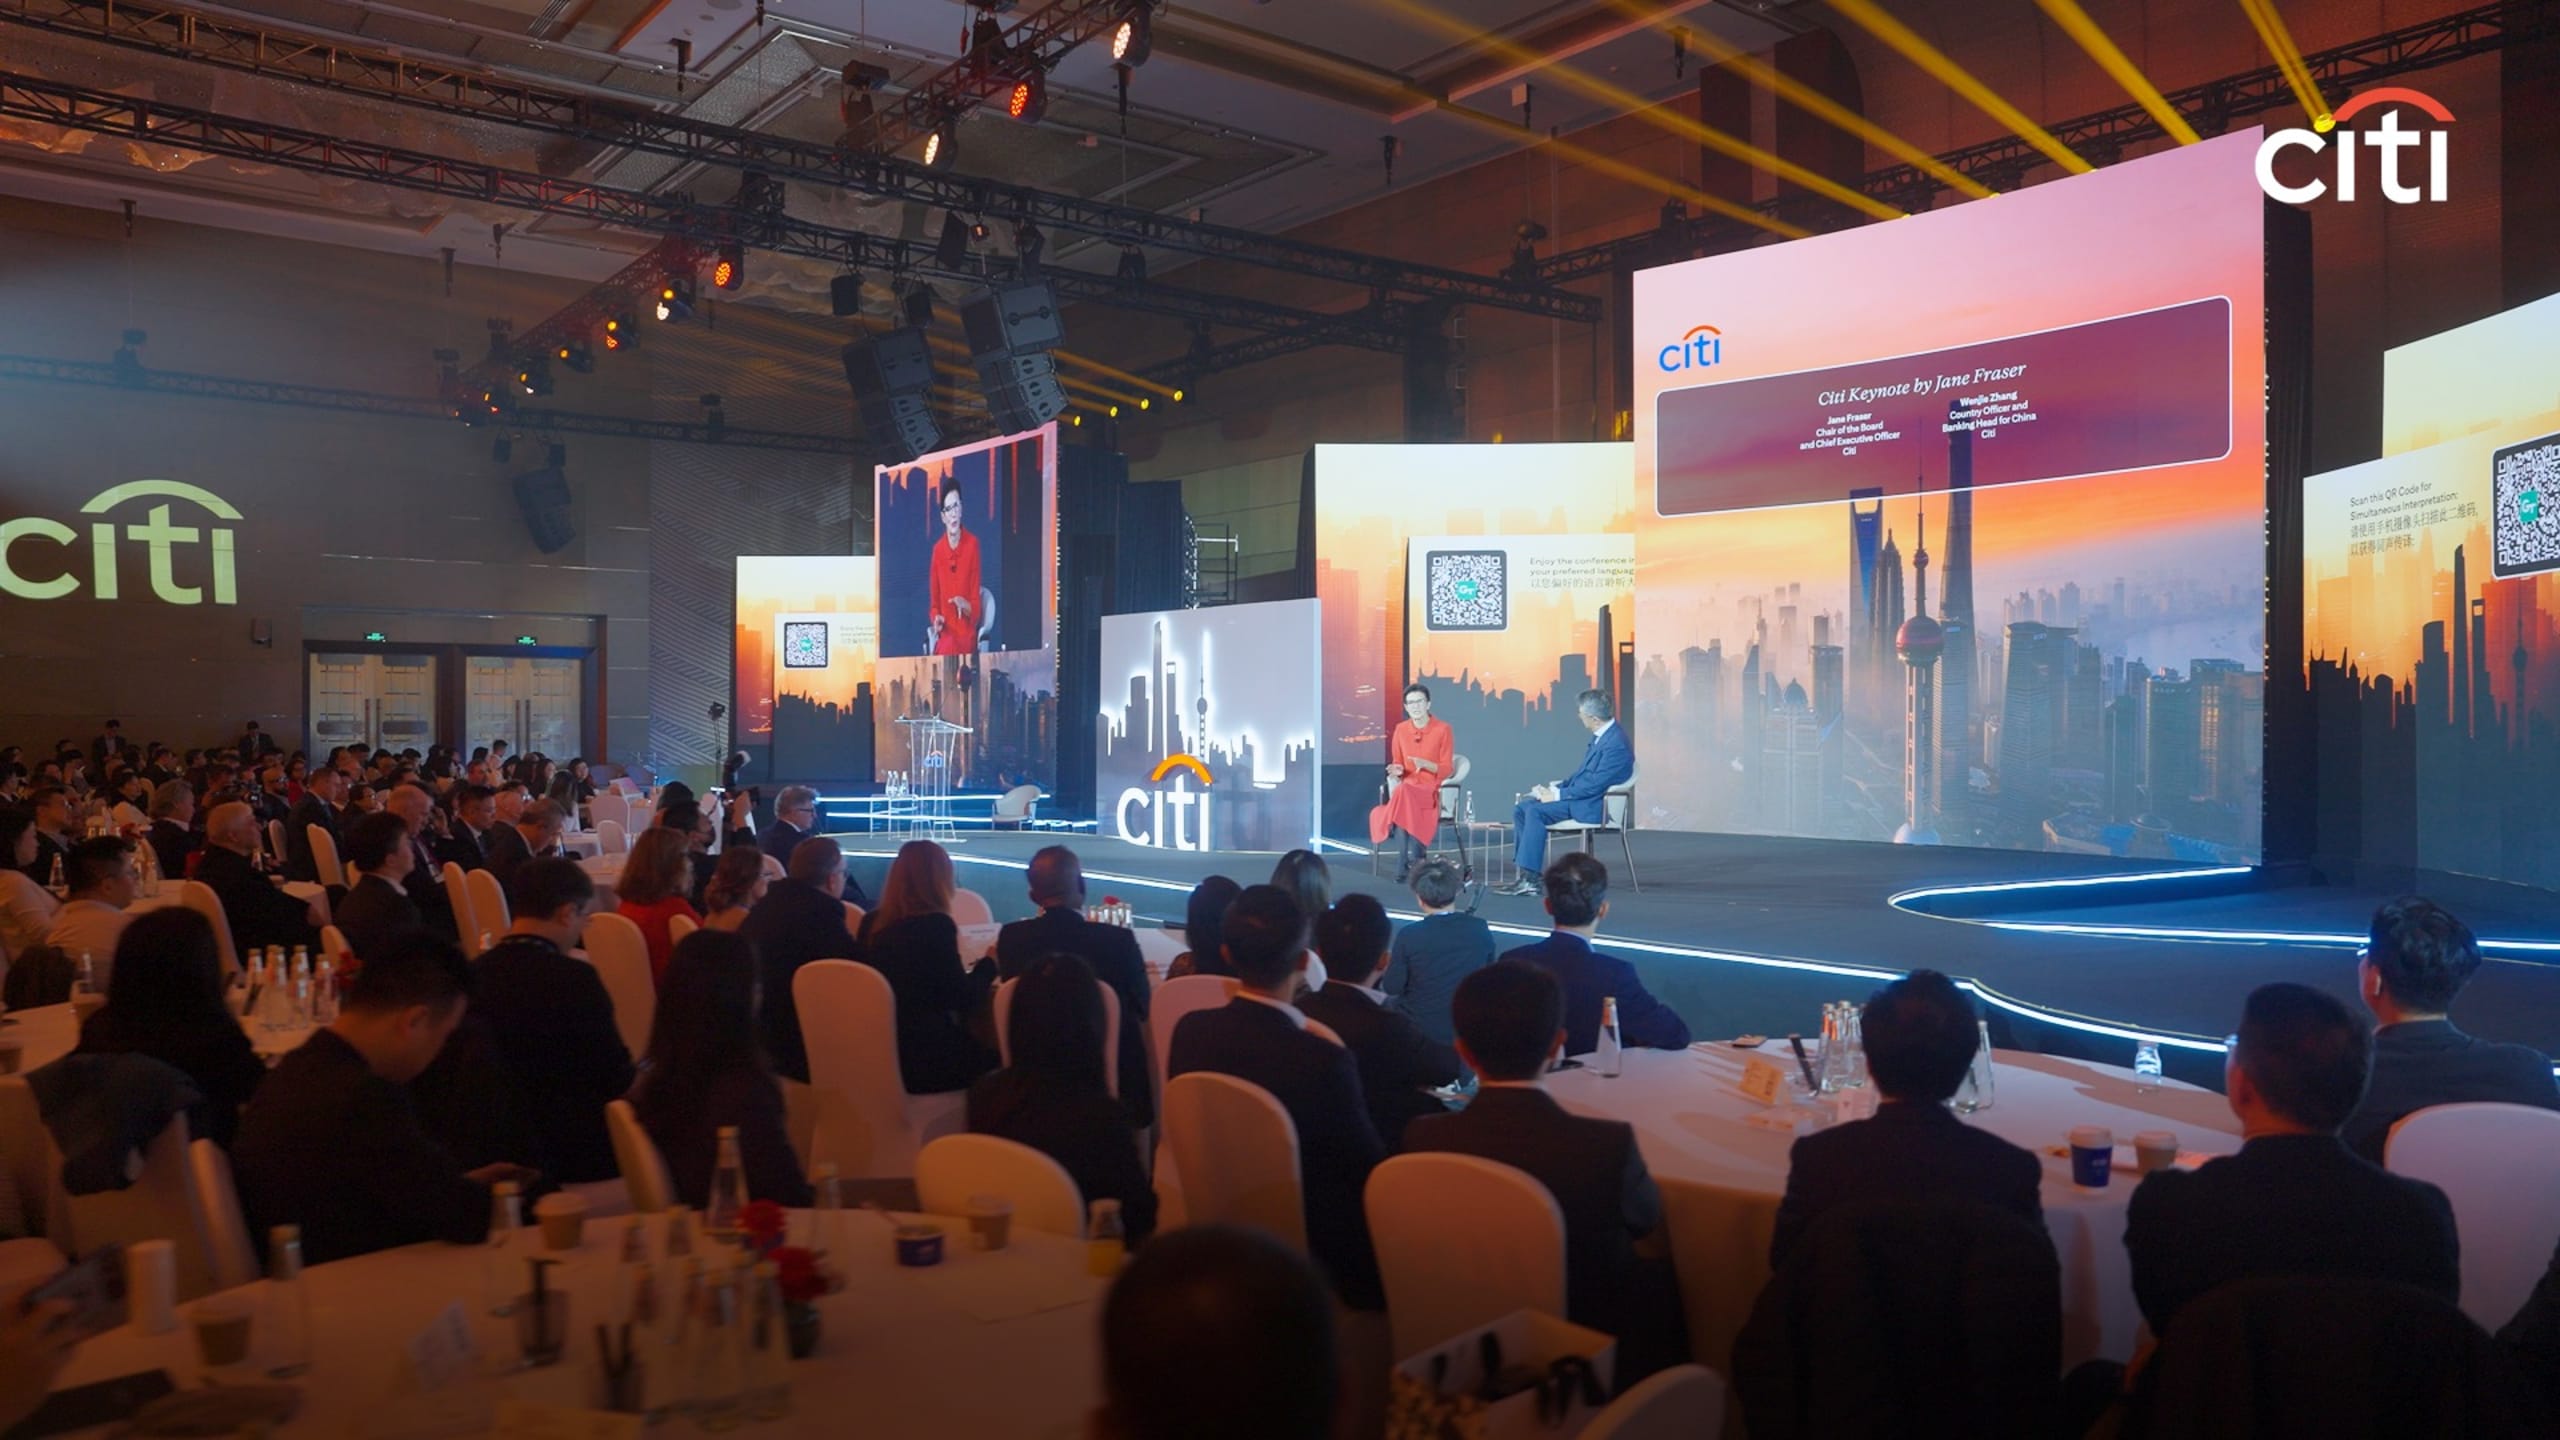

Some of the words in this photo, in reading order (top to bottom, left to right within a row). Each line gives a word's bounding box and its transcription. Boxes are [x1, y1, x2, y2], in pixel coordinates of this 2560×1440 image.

[1659, 334, 1720, 372] citi
[1818, 390, 1845, 406] Citi
[1848, 382, 1911, 404] Keynote
[1913, 377, 1933, 395] by
[1934, 374, 1971, 394] Jane
[1972, 364, 2027, 384] Fraser
[1960, 395, 1989, 407] Wenjie
[1989, 391, 2018, 402] Zhang
[1827, 416, 1846, 425] Jane
[1846, 413, 1873, 423] Fraser
[1949, 409, 1982, 420] Country
[1983, 404, 2011, 415] Officer
[2012, 400, 2028, 411] and
[1816, 427, 1837, 437] Chair
[1837, 425, 1846, 434] of
[1846, 424, 1860, 433] the
[1860, 420, 1884, 432] Board
[1942, 421, 1975, 433] Banking
[1976, 416, 1998, 428] Head
[1999, 415, 2010, 425] for
[2011, 412, 2037, 423] China
[1800, 440, 1816, 450] and
[1816, 438, 1836, 448] Chief
[1837, 434, 1874, 446] Executive
[1874, 431, 1901, 441] Officer
[1981, 428, 1996, 439] Citi
[1842, 446, 1857, 456] Citi
[2350, 496, 2369, 508] Scan
[2370, 491, 2384, 504] this
[2385, 487, 2398, 501] QR
[2398, 483, 2420, 498] Code
[2420, 480, 2432, 492] for
[2350, 504, 2401, 521] Simultaneous
[0, 503, 237, 605] citi
[1529, 557, 1554, 567] Enjoy
[1558, 558, 1574, 566] the
[1574, 557, 1627, 566] conference
[1529, 568, 1551, 577] your
[1552, 567, 1596, 576] preferred
[1117, 774, 1210, 852] citi
